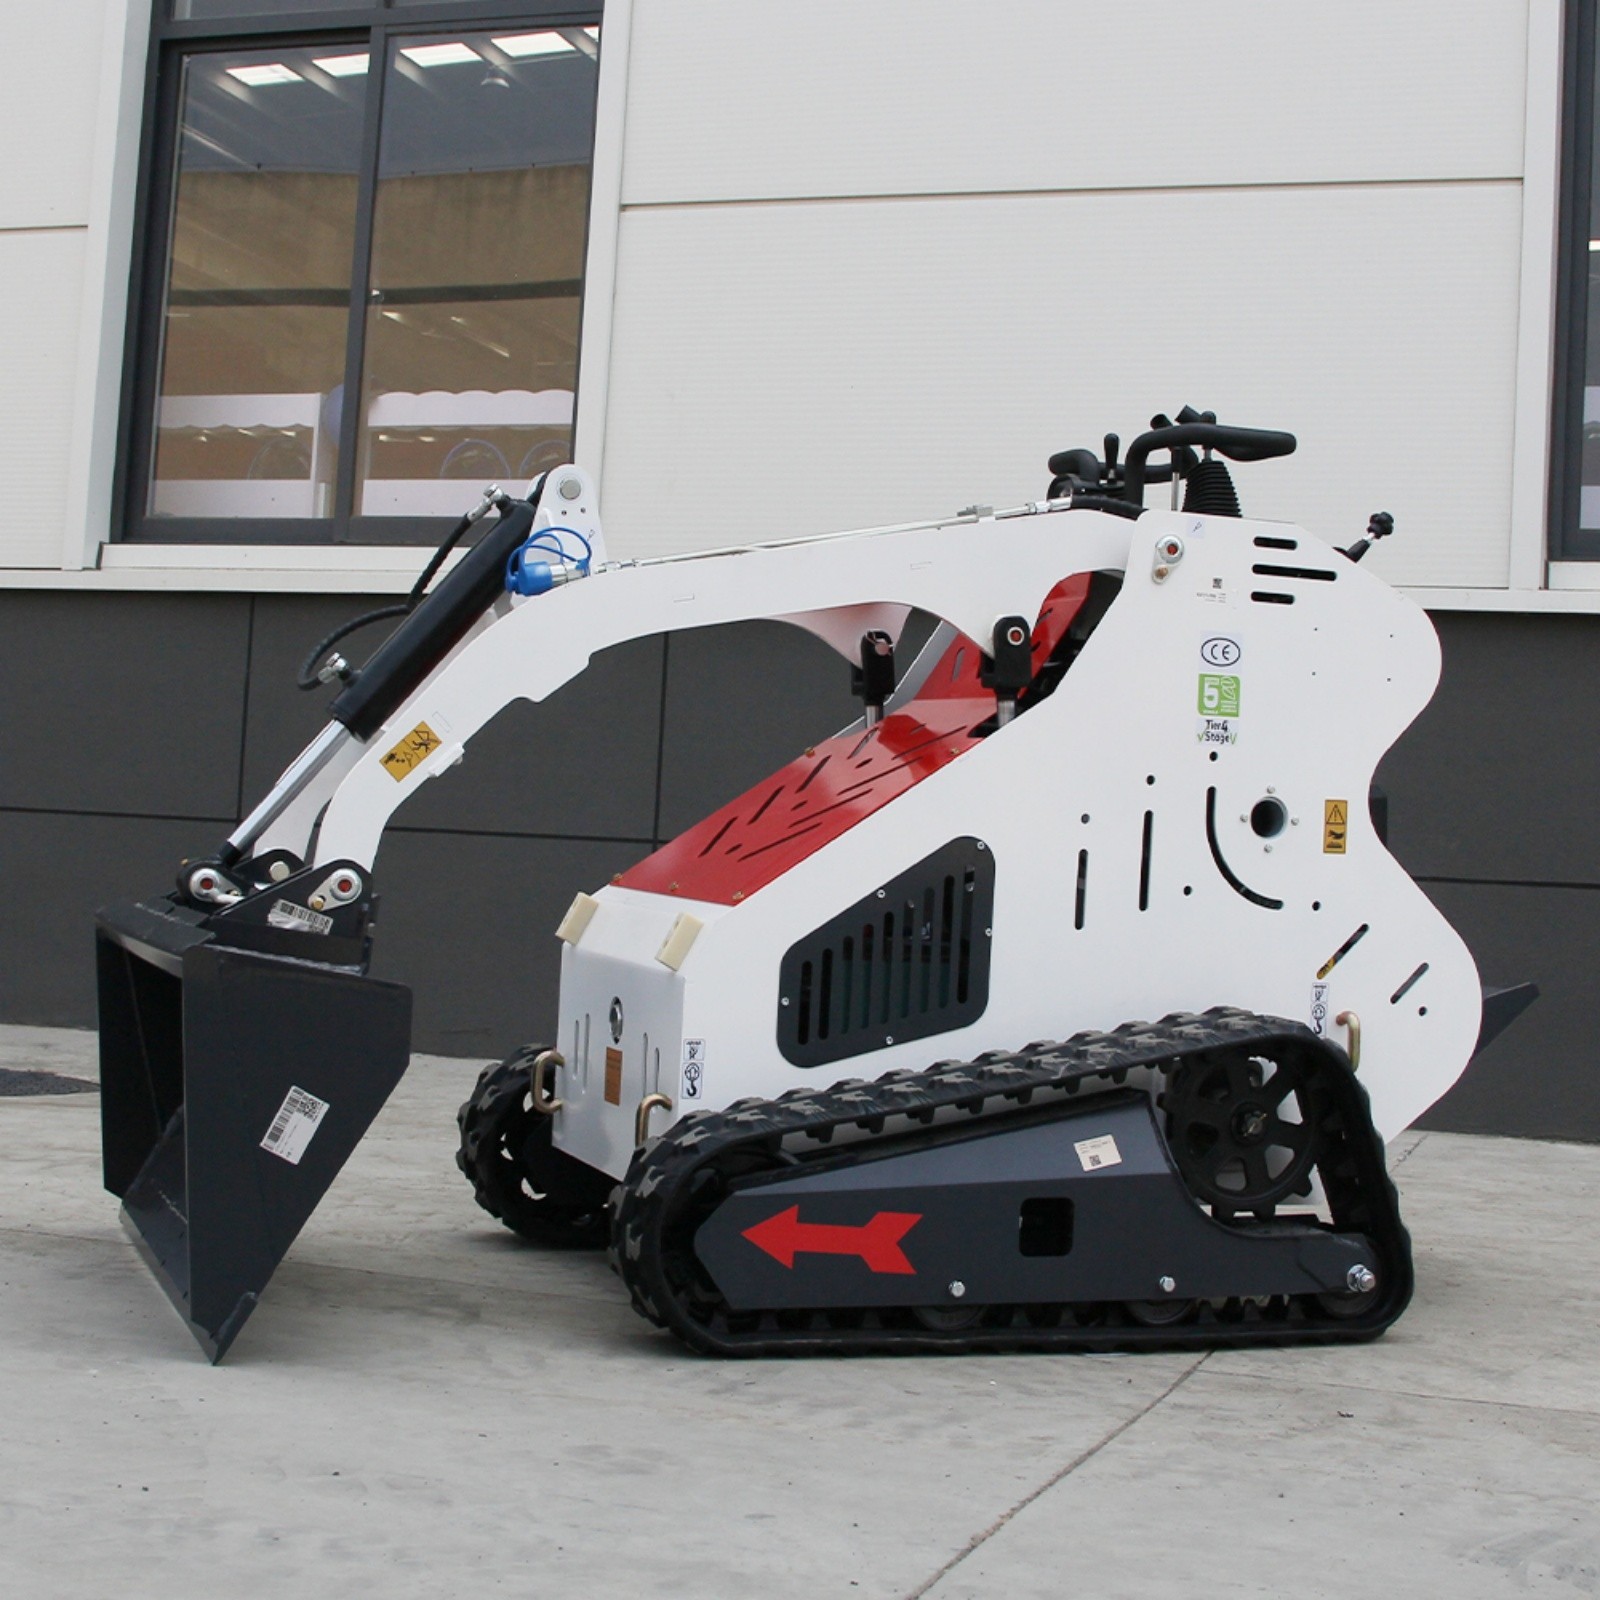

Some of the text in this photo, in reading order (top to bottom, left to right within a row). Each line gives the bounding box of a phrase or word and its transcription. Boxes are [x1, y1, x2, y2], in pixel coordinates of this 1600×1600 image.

[1211, 643, 1230, 661] CE
[1203, 677, 1220, 708] 5
[1205, 731, 1229, 745] Stage
